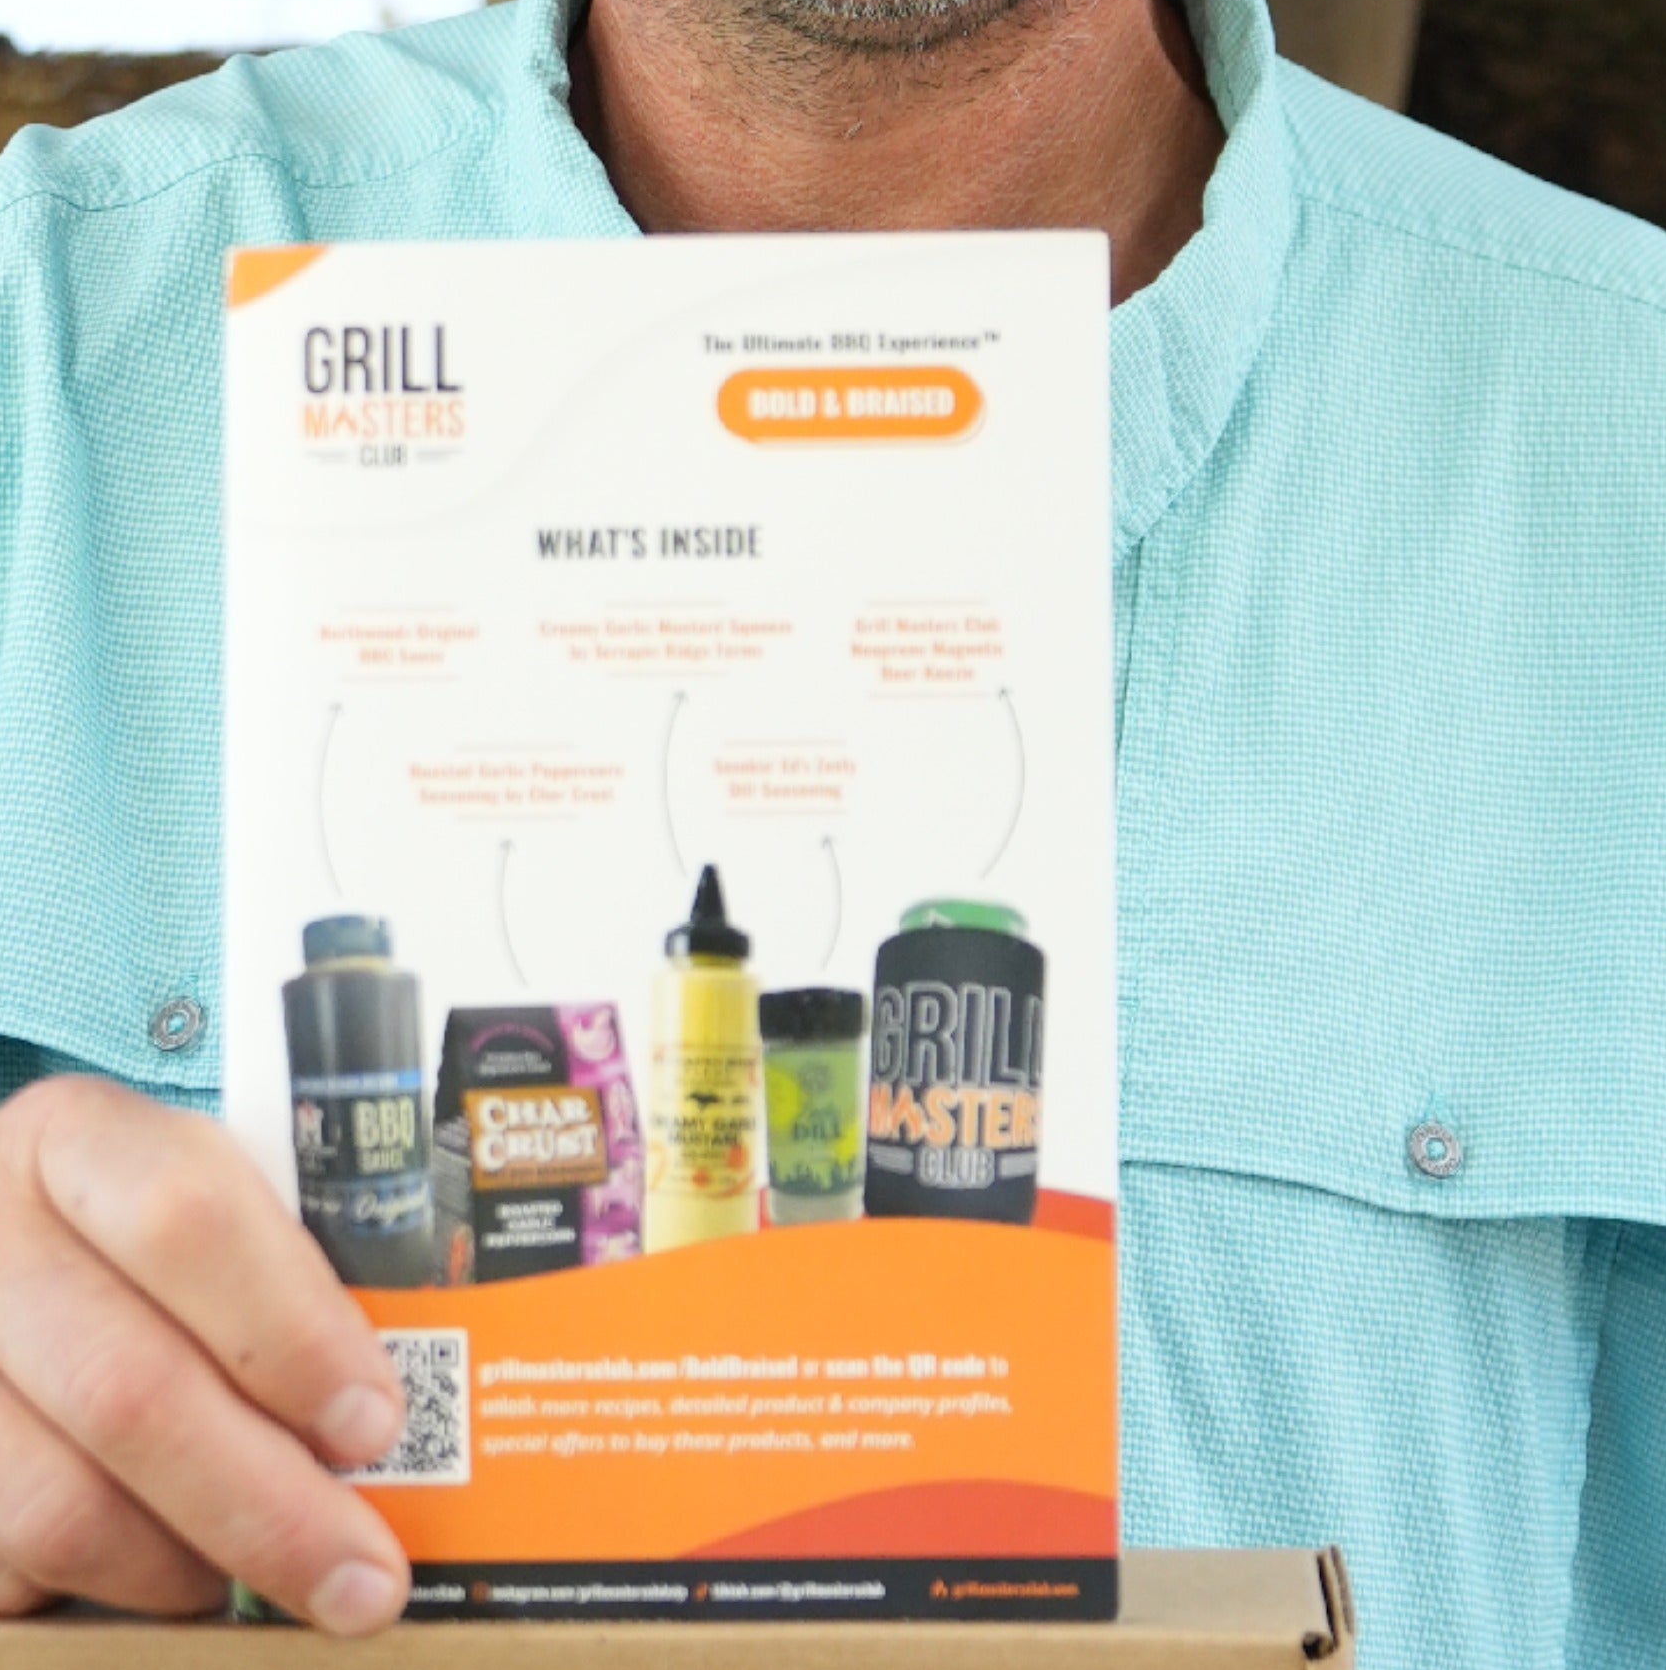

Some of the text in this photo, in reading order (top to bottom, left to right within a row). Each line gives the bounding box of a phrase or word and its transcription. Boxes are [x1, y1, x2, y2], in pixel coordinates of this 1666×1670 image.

[304, 324, 464, 395] GRILL
[703, 334, 733, 353] The
[742, 332, 822, 352] Ultimate
[830, 331, 870, 353] BBQ
[303, 399, 466, 439] MASTERS
[748, 385, 955, 421] BOLD & BRAISED
[359, 444, 408, 467] CLUB
[537, 526, 763, 560] WHAT'S INSIDE
[352, 1097, 418, 1151] BBQ
[478, 1097, 594, 1131] CHAR
[474, 1126, 602, 1173] CRUST
[919, 1149, 994, 1187] CLUB
[825, 1359, 869, 1378] scan
[872, 1356, 904, 1377] the
[941, 1355, 986, 1377] code
